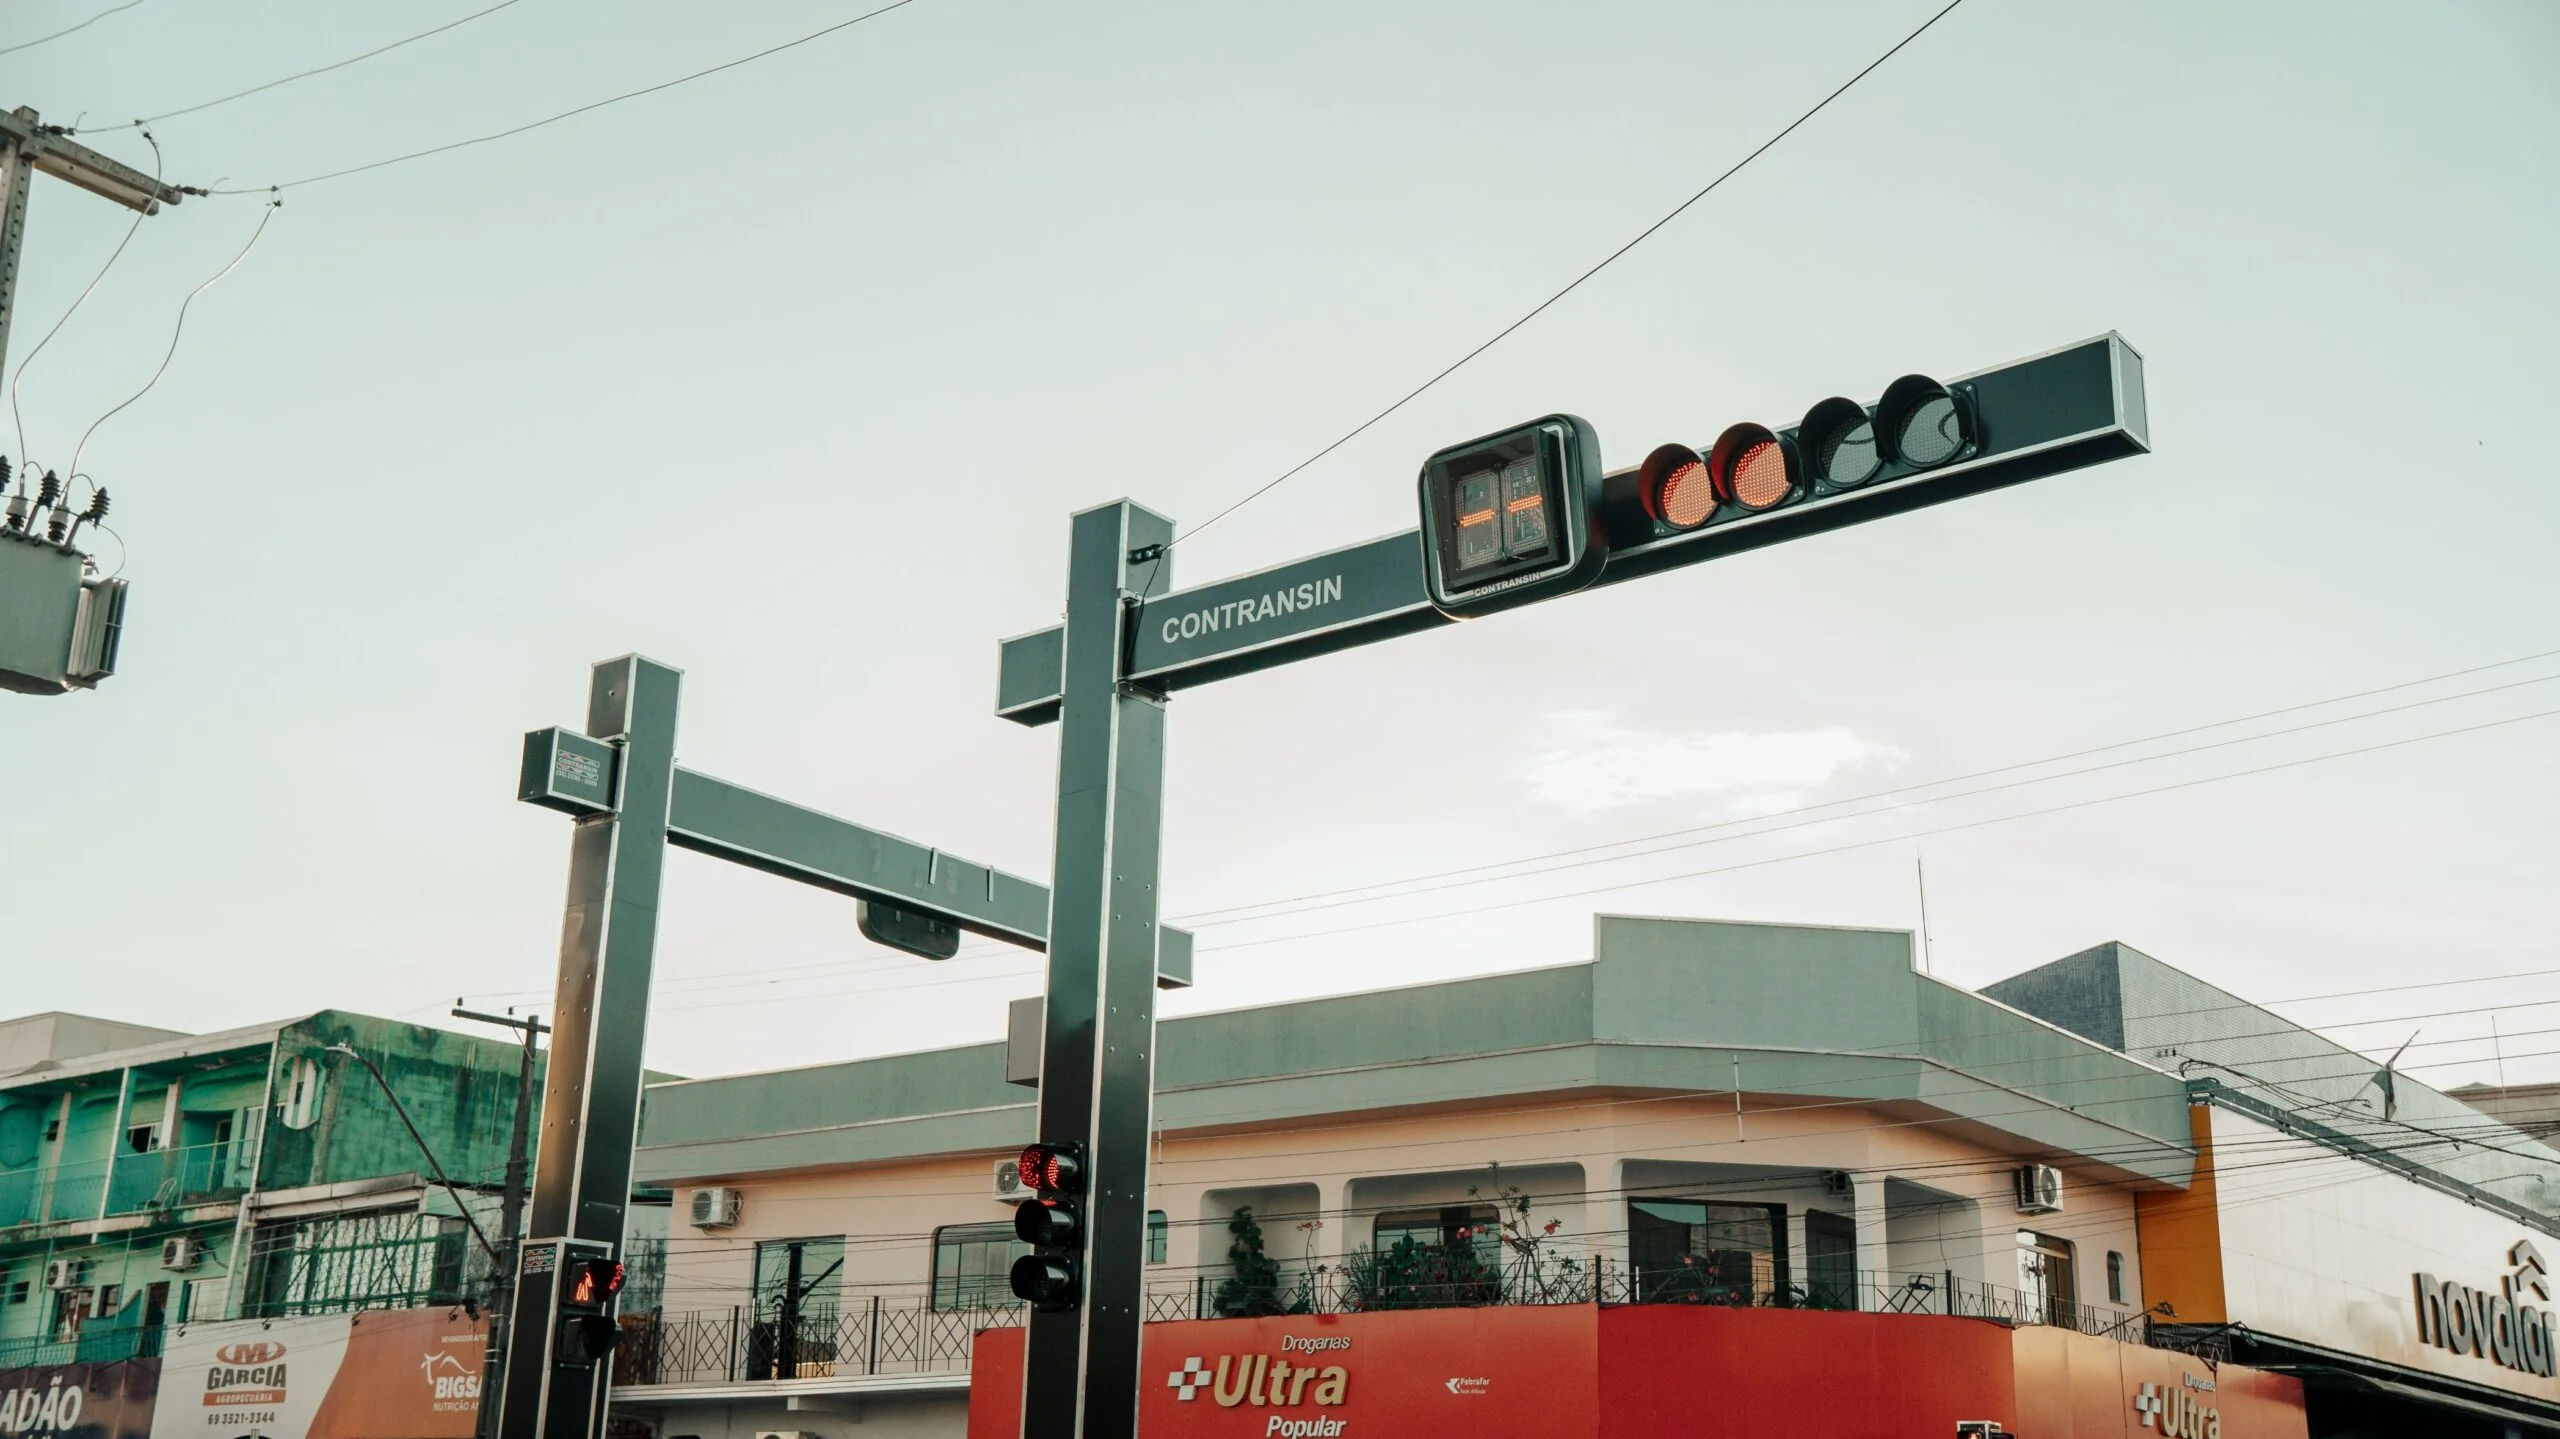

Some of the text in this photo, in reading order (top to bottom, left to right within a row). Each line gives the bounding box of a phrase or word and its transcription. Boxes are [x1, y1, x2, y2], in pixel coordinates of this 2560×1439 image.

[1474, 571, 1541, 597] CONTRANSIN
[1162, 575, 1342, 644] CONTRANSIN
[558, 757, 598, 774] CONTRANSIN
[2412, 1272, 2557, 1378] novalar
[1282, 1335, 1350, 1354] Drogarias
[206, 1363, 287, 1391] GARCIA
[1214, 1354, 1348, 1408] Ultra
[1460, 1377, 1491, 1385] Febrafar
[0, 1375, 83, 1432] ADÃO
[215, 1391, 273, 1404] AGROPECUÁRIA
[433, 1400, 469, 1412] NUTRIÇÃO
[208, 1411, 275, 1425] 69 3521-3344
[2161, 1384, 2220, 1439] Ultra
[1266, 1415, 1347, 1439] Popular
